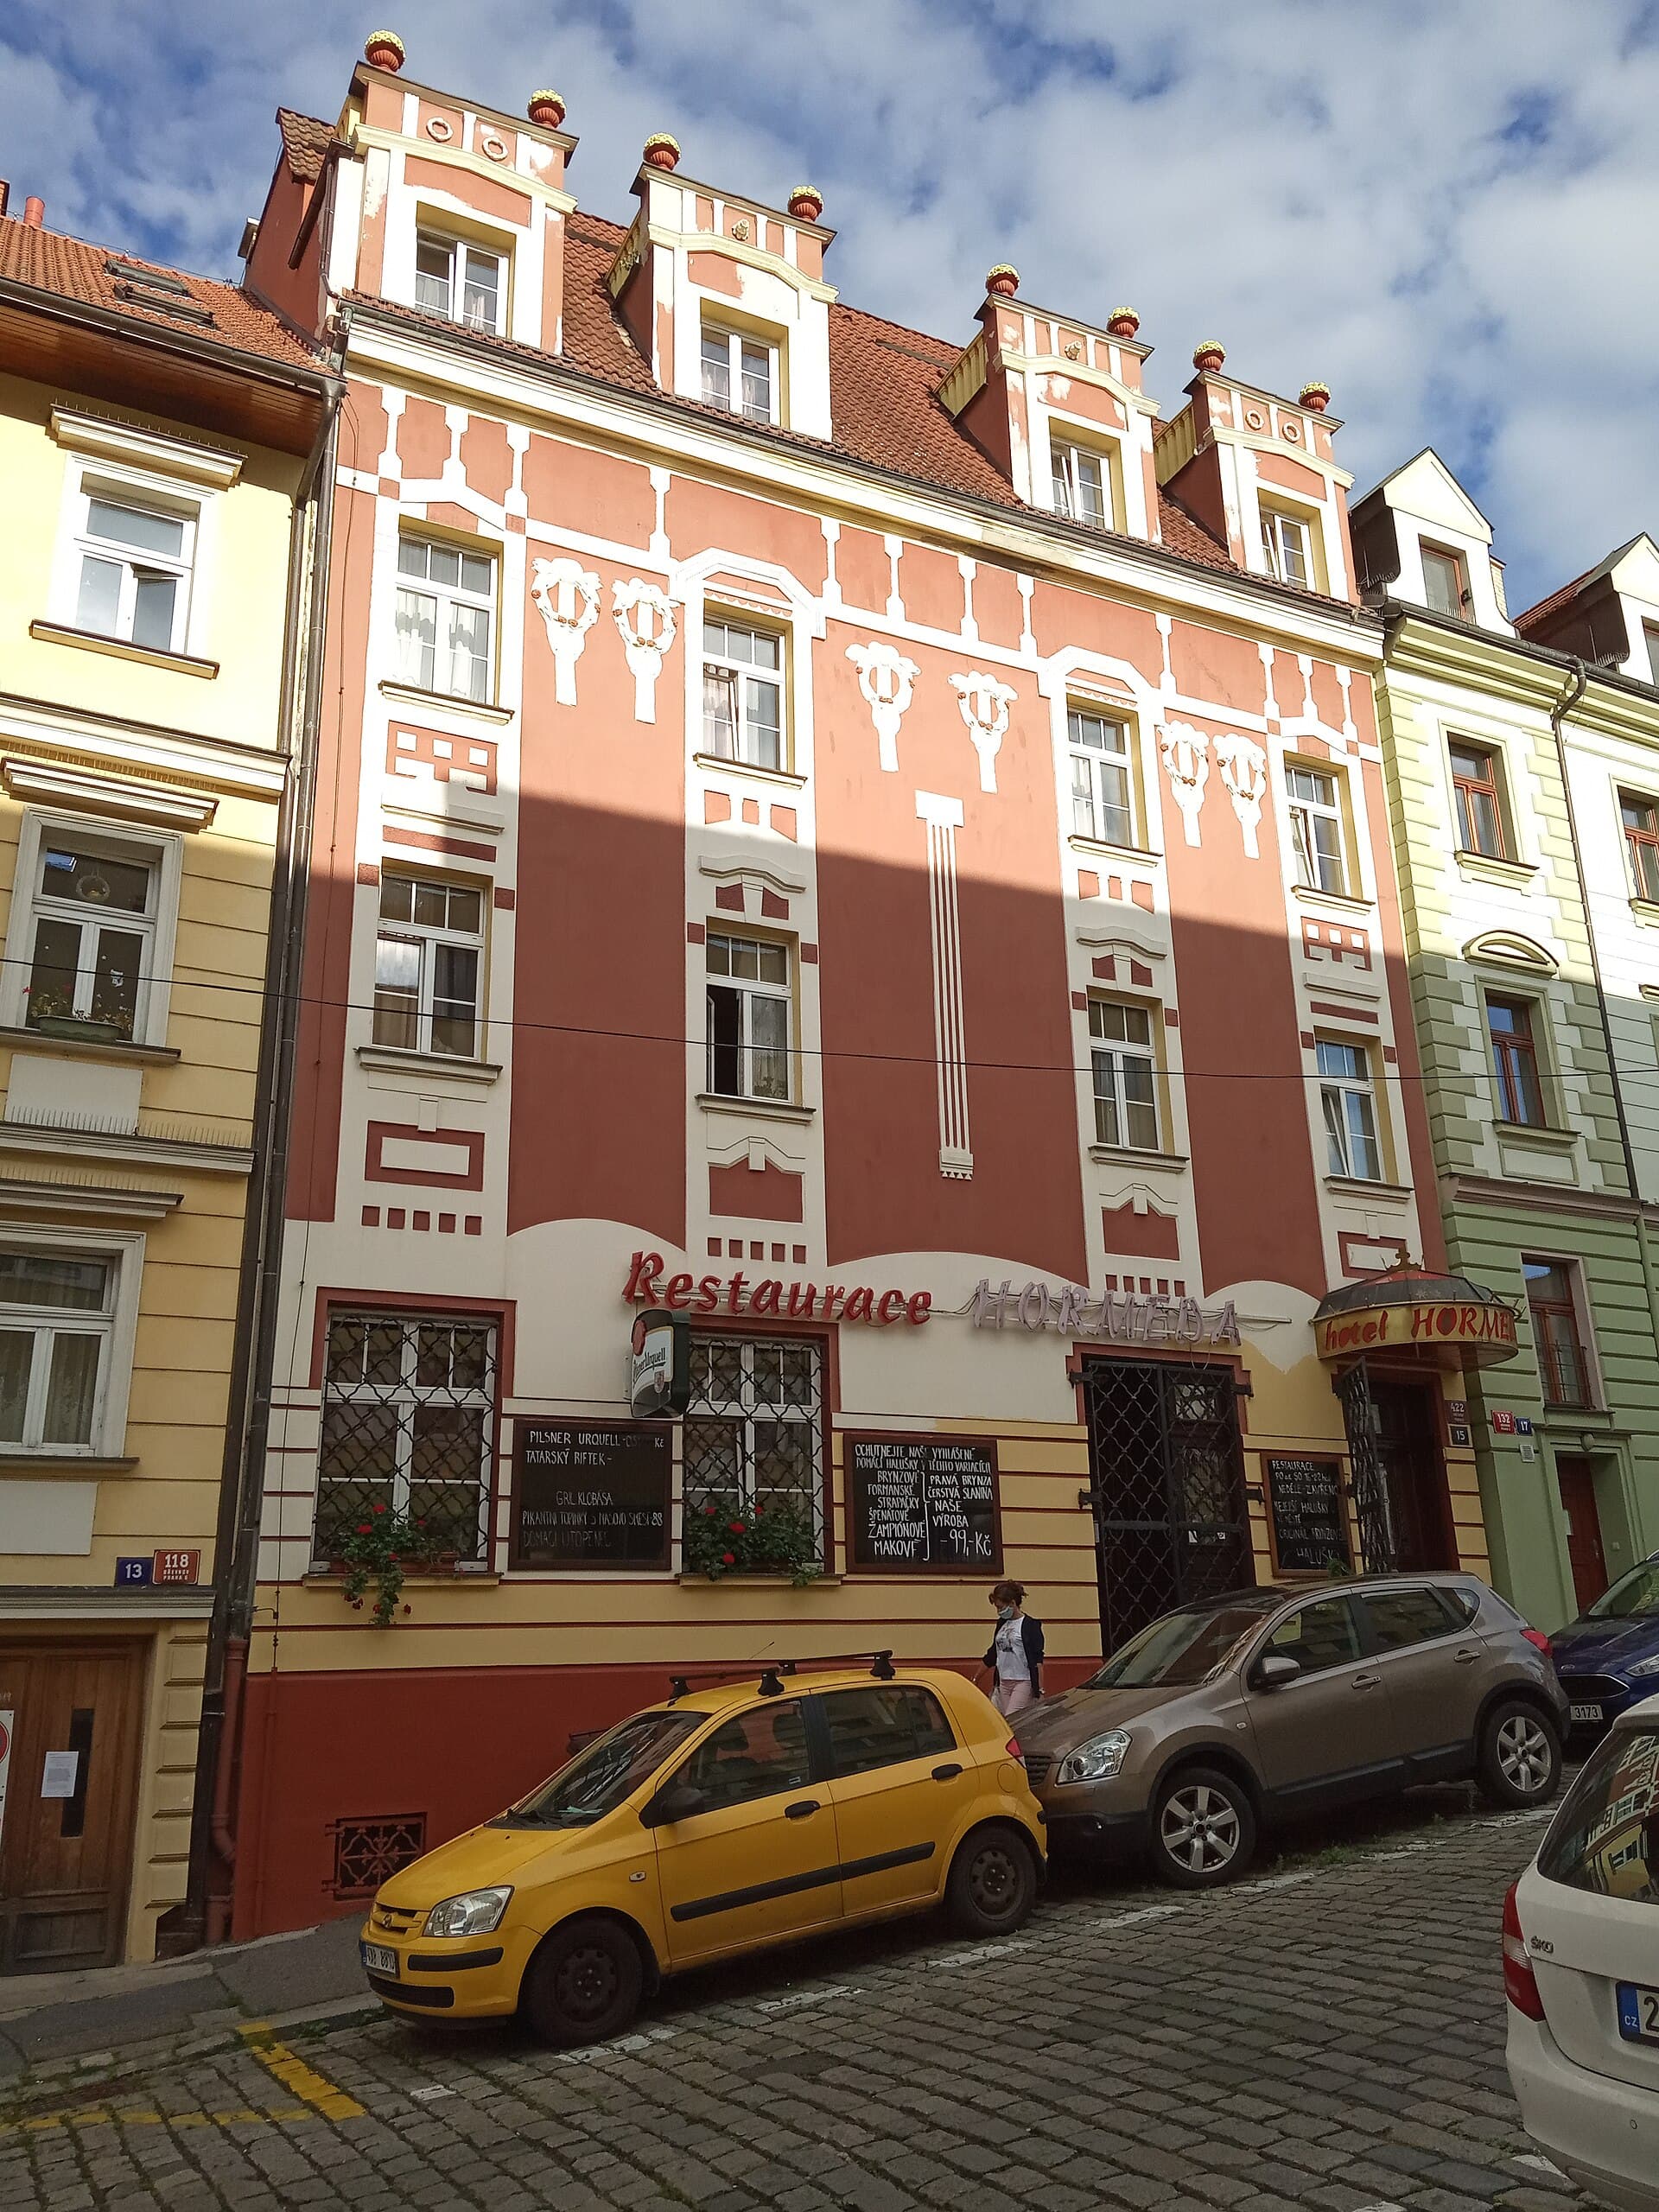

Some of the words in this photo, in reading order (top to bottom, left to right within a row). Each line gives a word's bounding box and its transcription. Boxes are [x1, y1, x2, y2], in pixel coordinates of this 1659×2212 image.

[622, 1250, 931, 1325] Restaurace
[974, 1279, 1242, 1346] HORMEDA
[1325, 1310, 1389, 1351] hotel
[1497, 1414, 1510, 1423] 132
[1521, 1421, 1528, 1431] 17
[530, 1431, 571, 1445] PILSNER
[579, 1433, 620, 1446] URQUELL
[1456, 1430, 1465, 1440] 15
[525, 1448, 570, 1465] TATARSKÝ
[574, 1452, 606, 1465] BIFTEK
[855, 1444, 905, 1458] OCHUTNEJTE
[909, 1446, 928, 1459] NAŠ
[930, 1473, 958, 1485] PRAVÁ
[962, 1475, 992, 1486] BRYNZA
[928, 1486, 960, 1499] ČERSTVÁ
[935, 1498, 963, 1513] NAŠE
[932, 1513, 969, 1528] VÝROBA
[874, 1539, 921, 1558] MAKOVÉ
[1296, 1547, 1339, 1564] HALUŠK
[165, 1554, 189, 1568] 118
[125, 1563, 143, 1579] 13
[1575, 1707, 1598, 1718] 3173
[1624, 2015, 1638, 2028] CZ
[1643, 1996, 1659, 2032] 2
